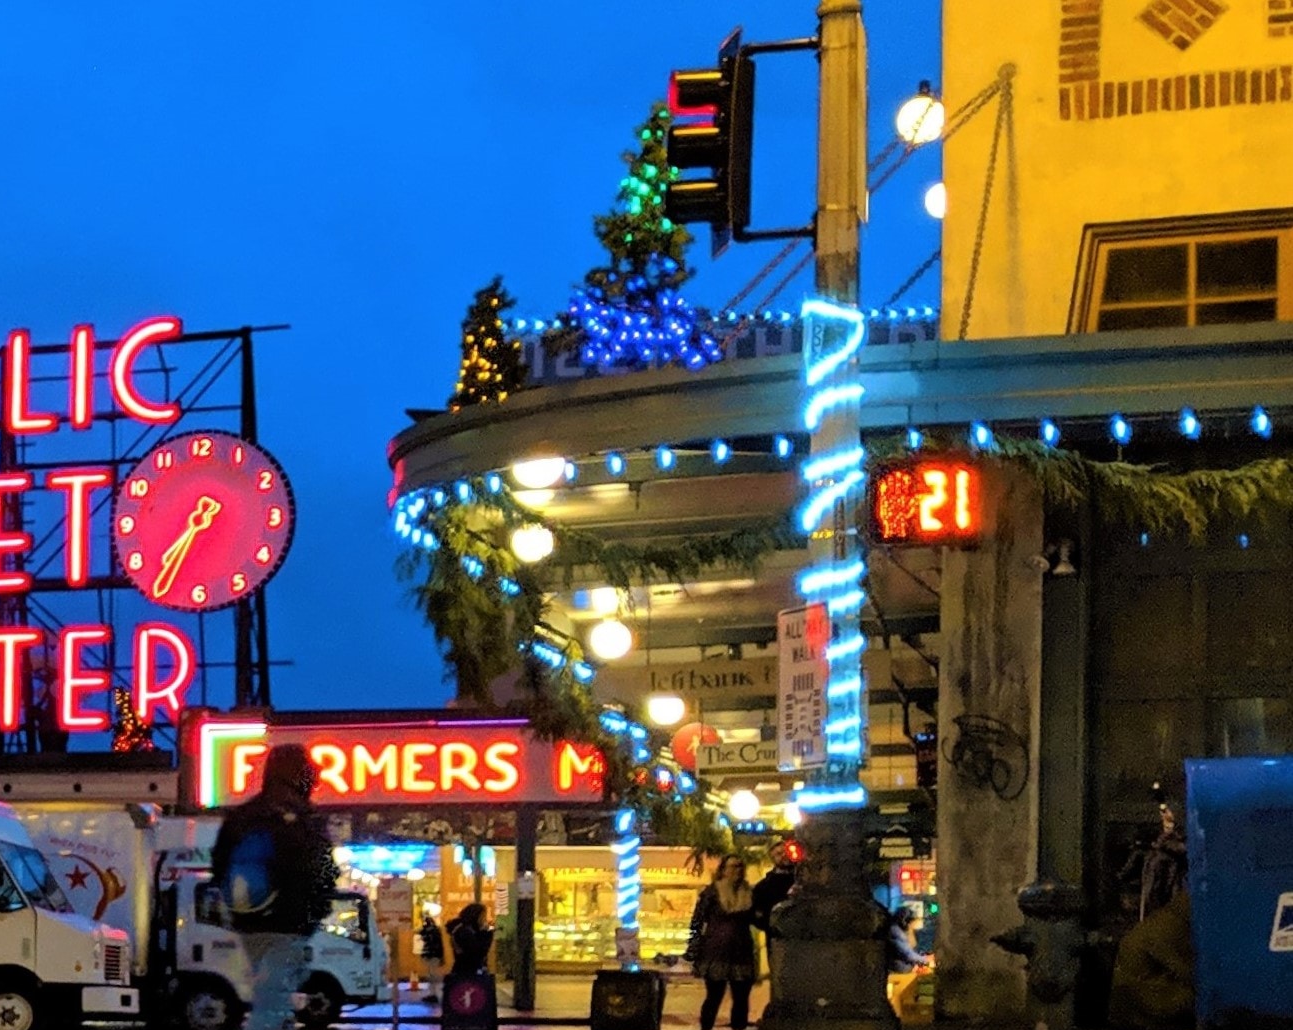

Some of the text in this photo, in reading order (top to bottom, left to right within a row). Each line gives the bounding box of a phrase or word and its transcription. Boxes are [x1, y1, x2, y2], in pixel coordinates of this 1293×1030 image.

[192, 439, 212, 456] 12
[235, 447, 243, 464] 1
[157, 452, 172, 468] 11
[130, 479, 149, 497] 10
[259, 471, 272, 490] 2
[919, 469, 972, 531] 21
[119, 516, 135, 534] 9
[269, 507, 282, 527] 3
[128, 552, 143, 570] 8
[256, 546, 270, 564] 4
[234, 574, 246, 592] 5
[191, 584, 207, 603] 6
[230, 740, 520, 794] FRMERS
